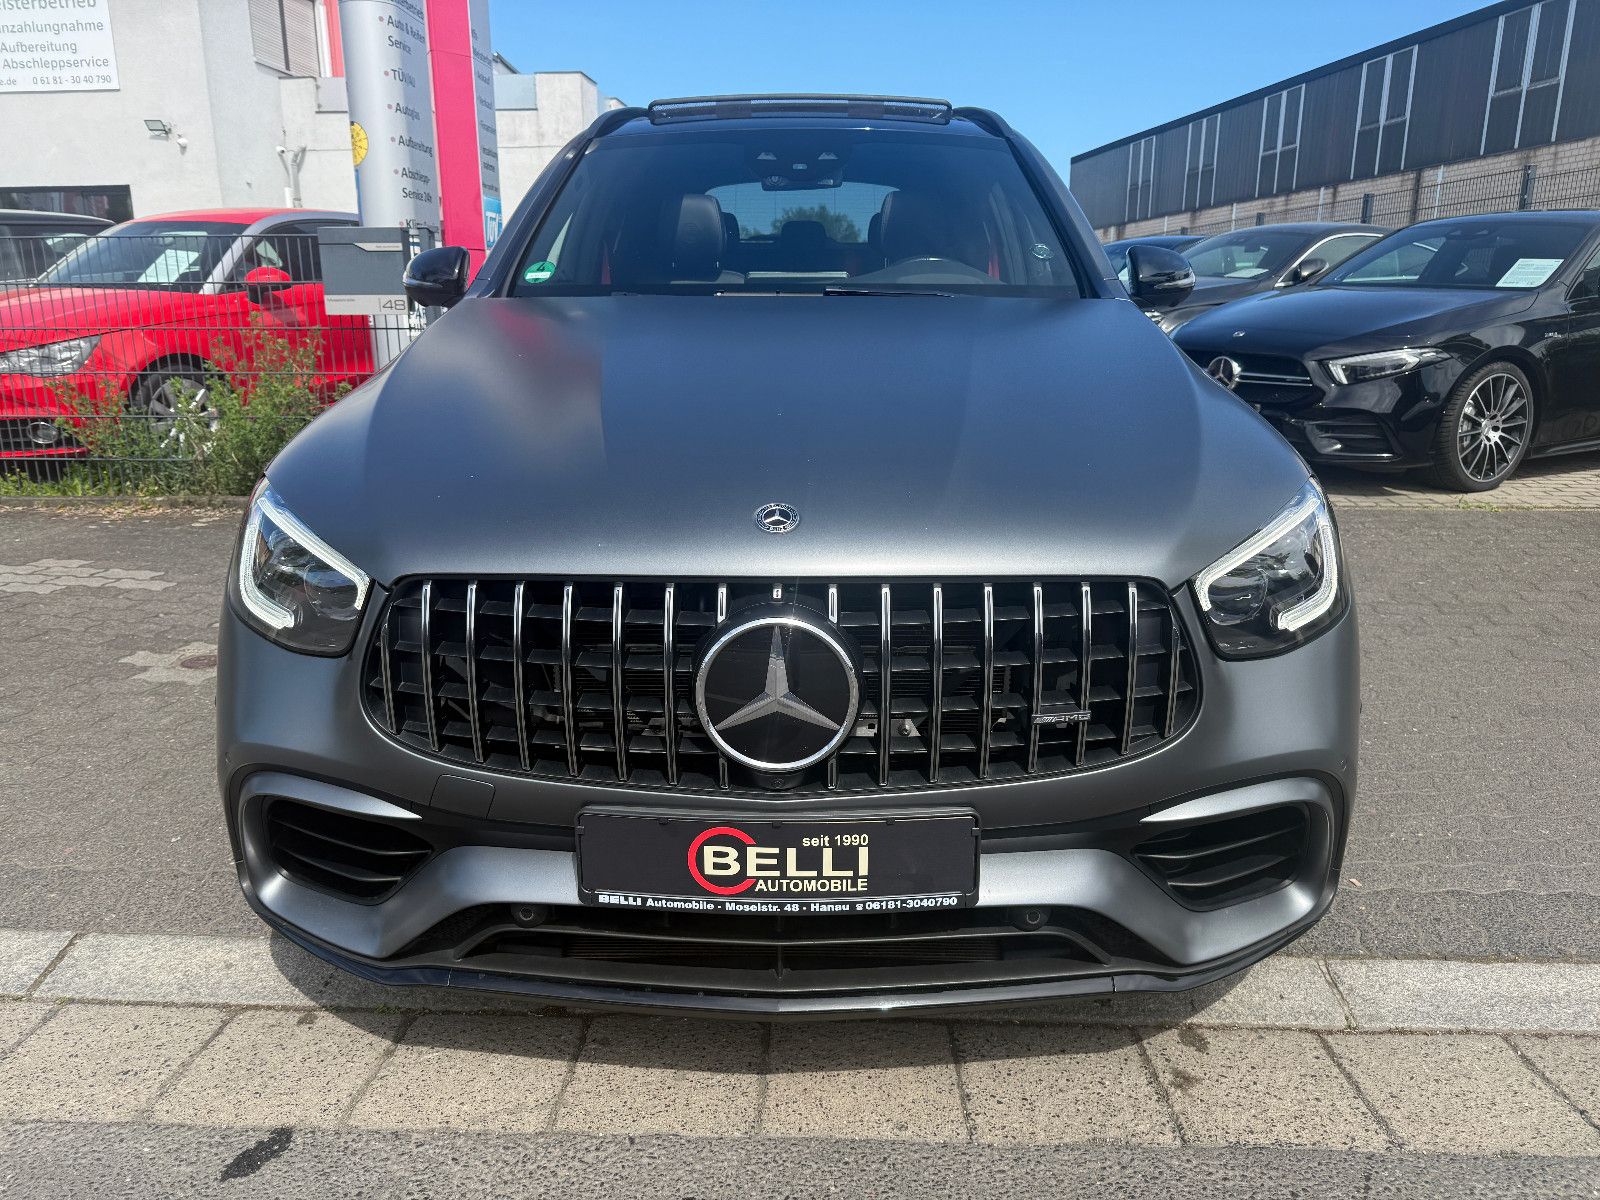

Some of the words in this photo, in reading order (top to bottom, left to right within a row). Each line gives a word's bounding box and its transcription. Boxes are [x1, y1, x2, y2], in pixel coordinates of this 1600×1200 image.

[0, 0, 96, 10] isterbetrieb
[0, 20, 104, 35] nzahlungnahme
[0, 40, 77, 54] Aufbereitung
[3, 56, 109, 71] Abschleppservice
[382, 299, 406, 311] 48
[802, 835, 830, 847] seit
[834, 834, 869, 846] 1990
[703, 845, 869, 877] BELLI
[755, 878, 868, 892] AUTOMOBILE
[598, 894, 642, 906] BELLI
[646, 898, 715, 910] Automobile
[725, 902, 781, 912] Moselstr.
[784, 903, 800, 912] 48
[810, 903, 850, 912] Hanau
[865, 897, 958, 911] 06181-3040790
